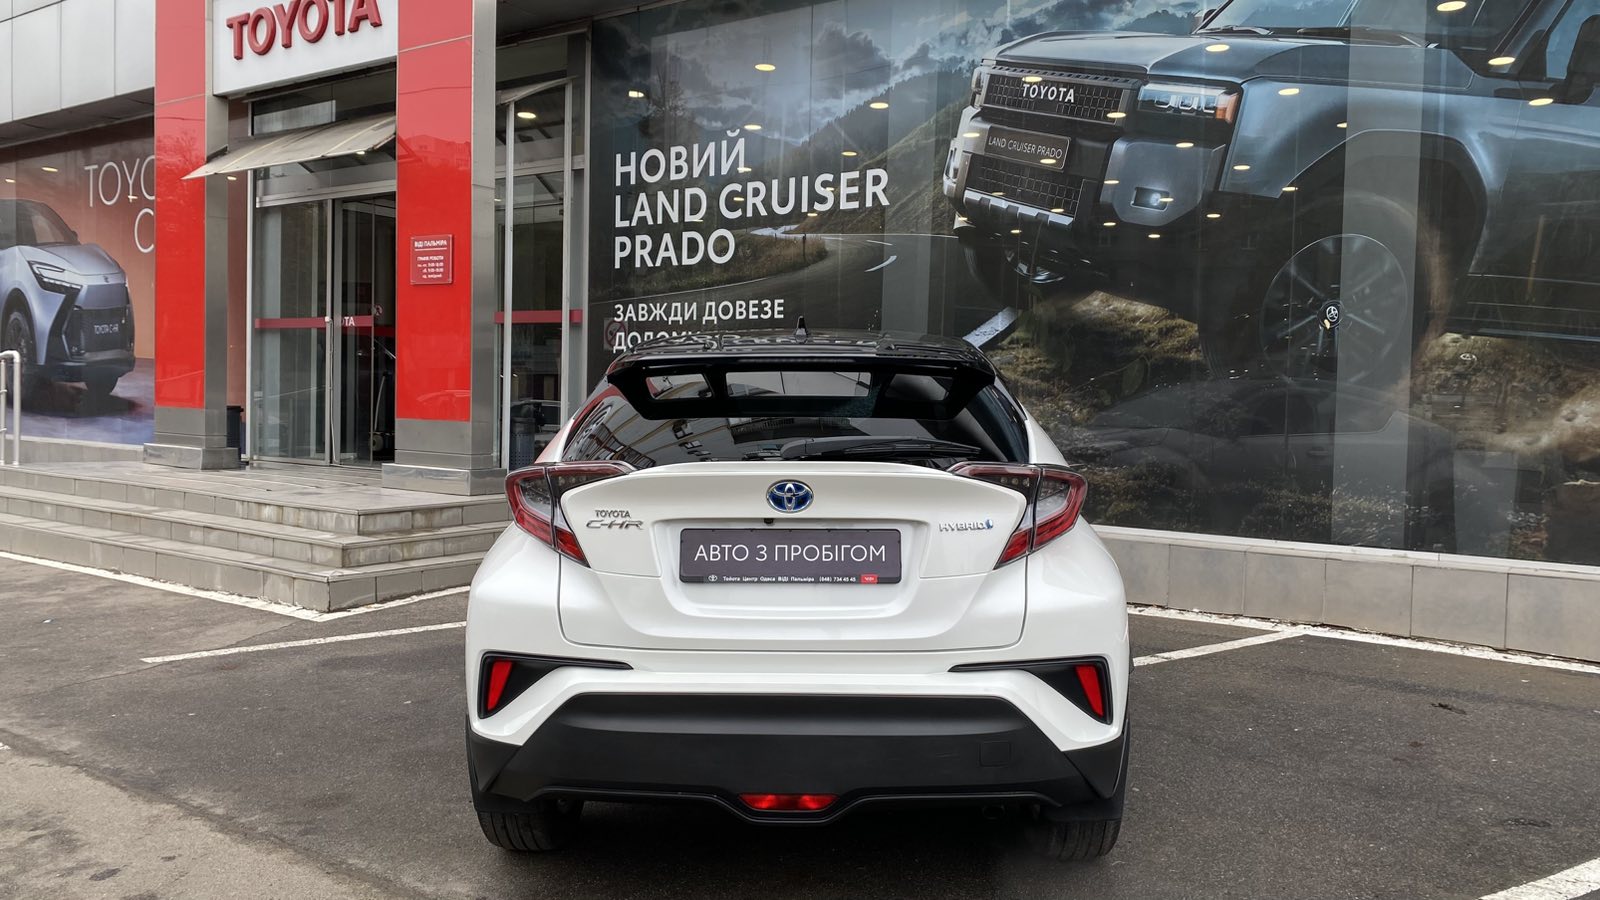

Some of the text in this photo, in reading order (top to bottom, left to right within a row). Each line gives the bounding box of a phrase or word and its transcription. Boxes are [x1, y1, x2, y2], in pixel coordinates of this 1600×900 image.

[226, 0, 382, 60] TOYOTA
[1022, 83, 1075, 103] TOYOTA
[615, 128, 746, 187] НОВИЙ
[988, 135, 1063, 160] LAND CRUISER PRADO
[614, 167, 890, 228] LAND CRUISER
[613, 228, 736, 270] PRADO
[613, 299, 785, 325] ЗАВЖДИ ДОВЕЗЕ
[586, 519, 644, 530] C-HR
[594, 509, 631, 519] TOYOTA
[938, 521, 985, 532] HYBRID
[694, 544, 886, 562] АВТО З ПРОБІГОМ
